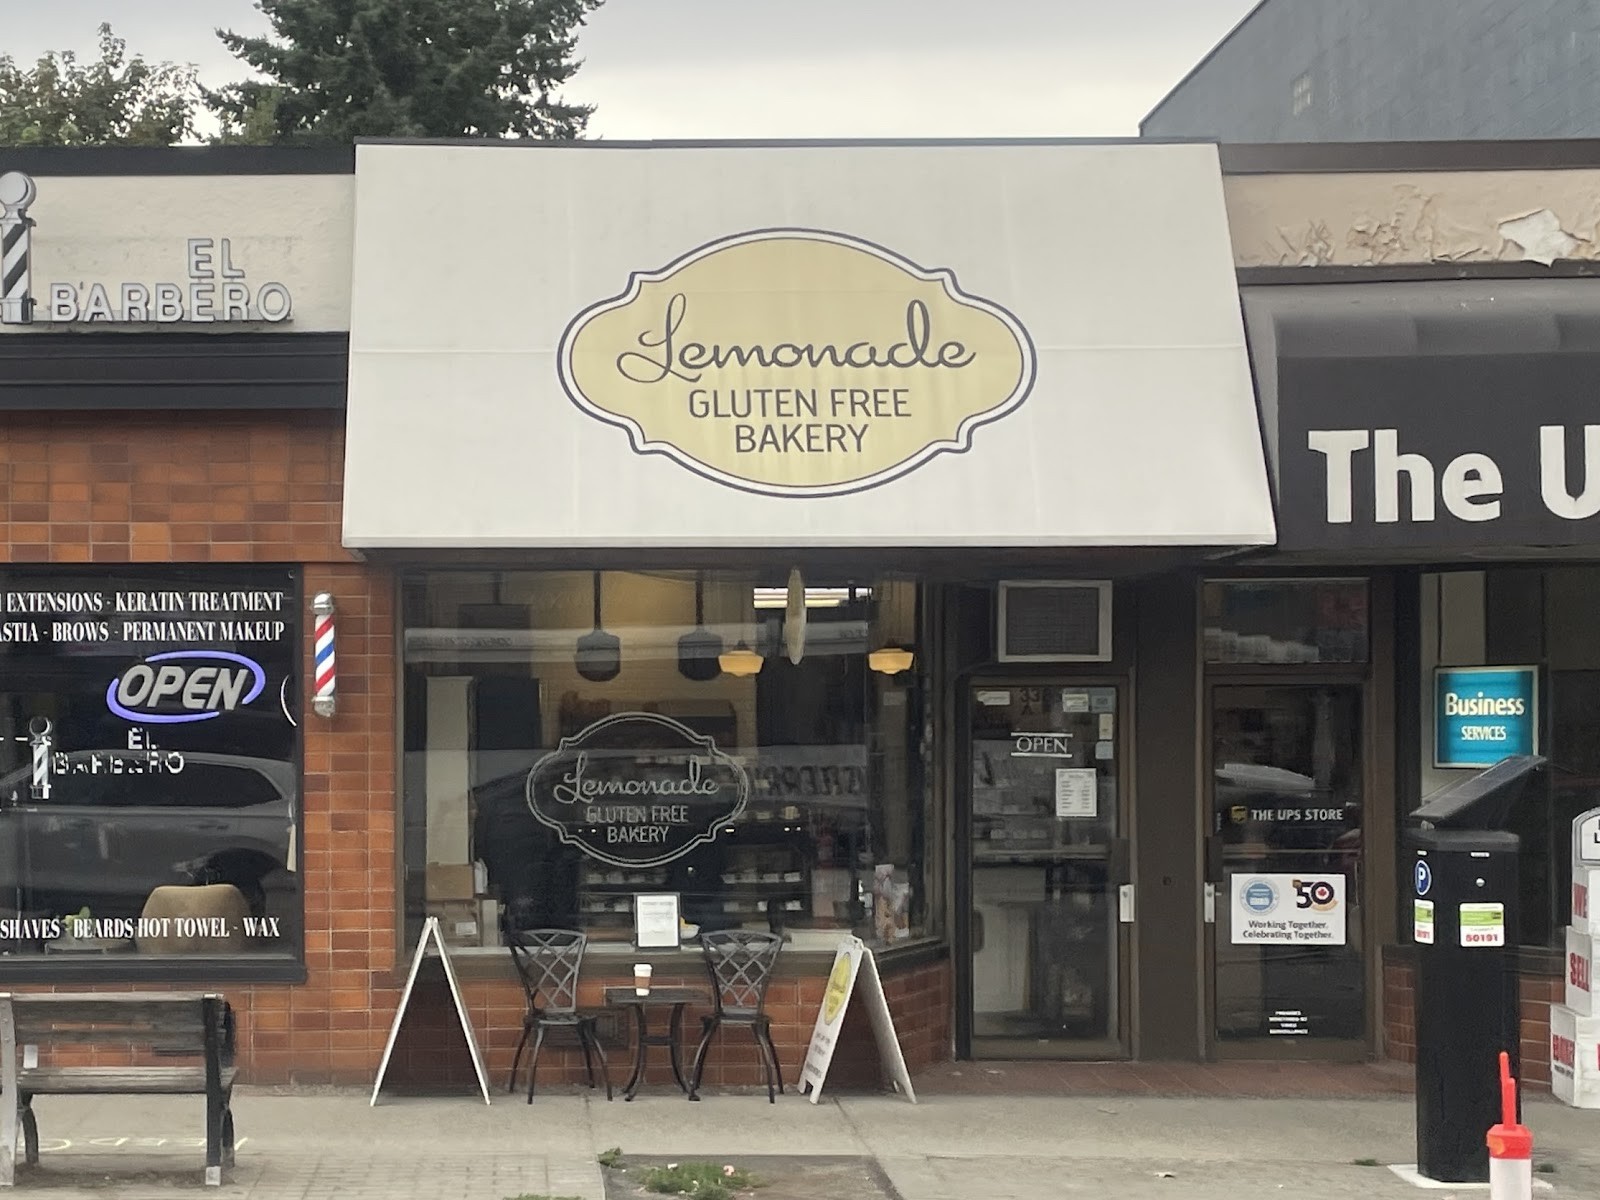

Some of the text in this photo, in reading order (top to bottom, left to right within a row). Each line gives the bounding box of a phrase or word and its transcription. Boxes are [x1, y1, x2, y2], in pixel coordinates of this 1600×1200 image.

[187, 238, 246, 279] EL
[50, 282, 293, 323] BARBERO
[615, 292, 978, 384] Lemonade
[689, 389, 912, 419] GLUTEN FREE
[735, 424, 869, 454] BAKERY
[1308, 424, 1600, 524] The U
[7, 592, 103, 613] EXTENSIONS
[115, 591, 184, 613] KERATIN
[189, 591, 284, 613] TREATMENT
[0, 621, 39, 643] STIA
[52, 621, 109, 643] BROWS
[123, 621, 216, 642] PERMANENT
[220, 621, 285, 642] MAKEUP
[117, 664, 249, 711] OPEN
[1444, 692, 1525, 716] Business
[128, 727, 159, 750] EL
[1016, 736, 1069, 753] OPEN
[1461, 726, 1507, 741] SERVICES
[553, 752, 720, 803] Lemonade
[586, 805, 689, 823] GLUTEN FREE
[1251, 808, 1344, 821] THE UPS STORE
[607, 826, 670, 843] BAKERY
[0, 918, 60, 939] SHAVES
[138, 918, 170, 938] HOT
[174, 918, 229, 938] TOWEL
[243, 917, 280, 938] WAX
[1242, 930, 1292, 940] Celebrating
[1248, 921, 1286, 930] Working
